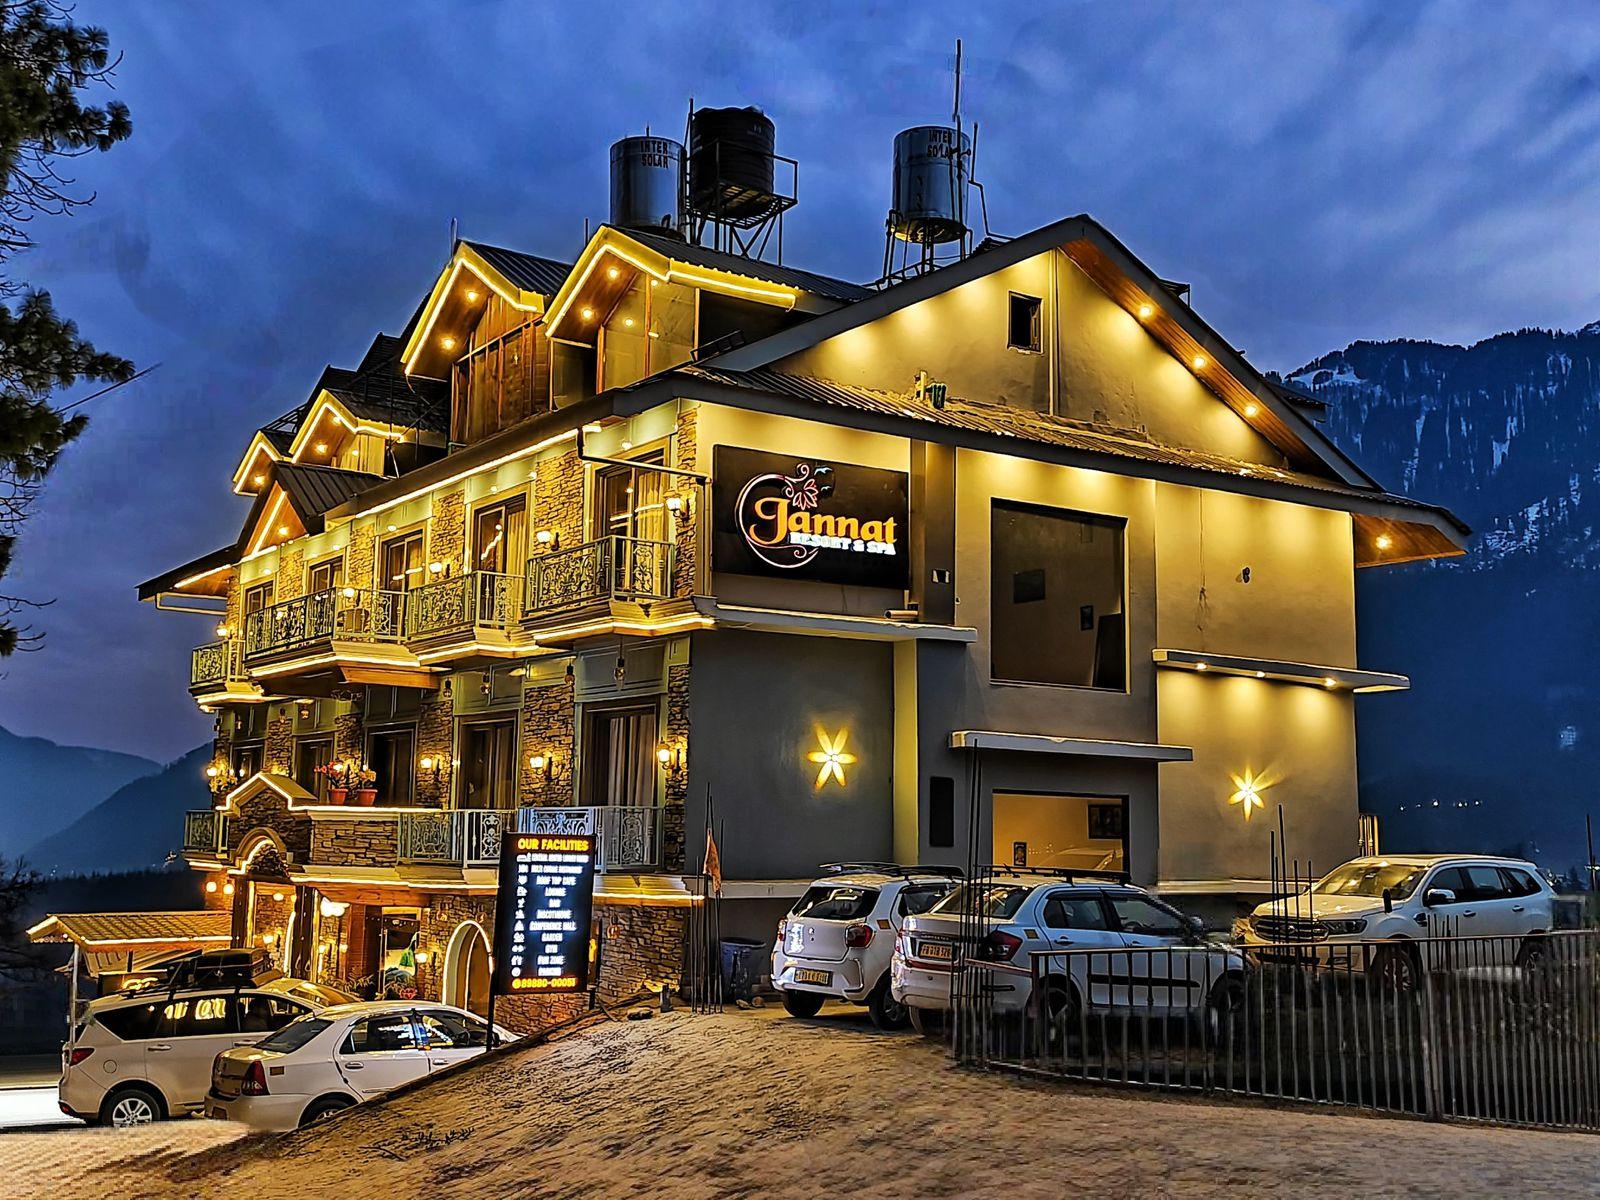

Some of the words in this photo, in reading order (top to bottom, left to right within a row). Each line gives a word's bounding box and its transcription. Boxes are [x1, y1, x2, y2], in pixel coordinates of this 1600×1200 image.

[929, 129, 952, 144] INTER
[640, 139, 668, 154] INTER
[641, 153, 669, 169] SOLAR
[749, 497, 897, 545] Jannat
[790, 532, 851, 549] RESORT
[853, 540, 864, 551] &
[867, 541, 896, 555] SPA
[517, 838, 540, 850] OUR
[541, 838, 589, 851] FACILITIES
